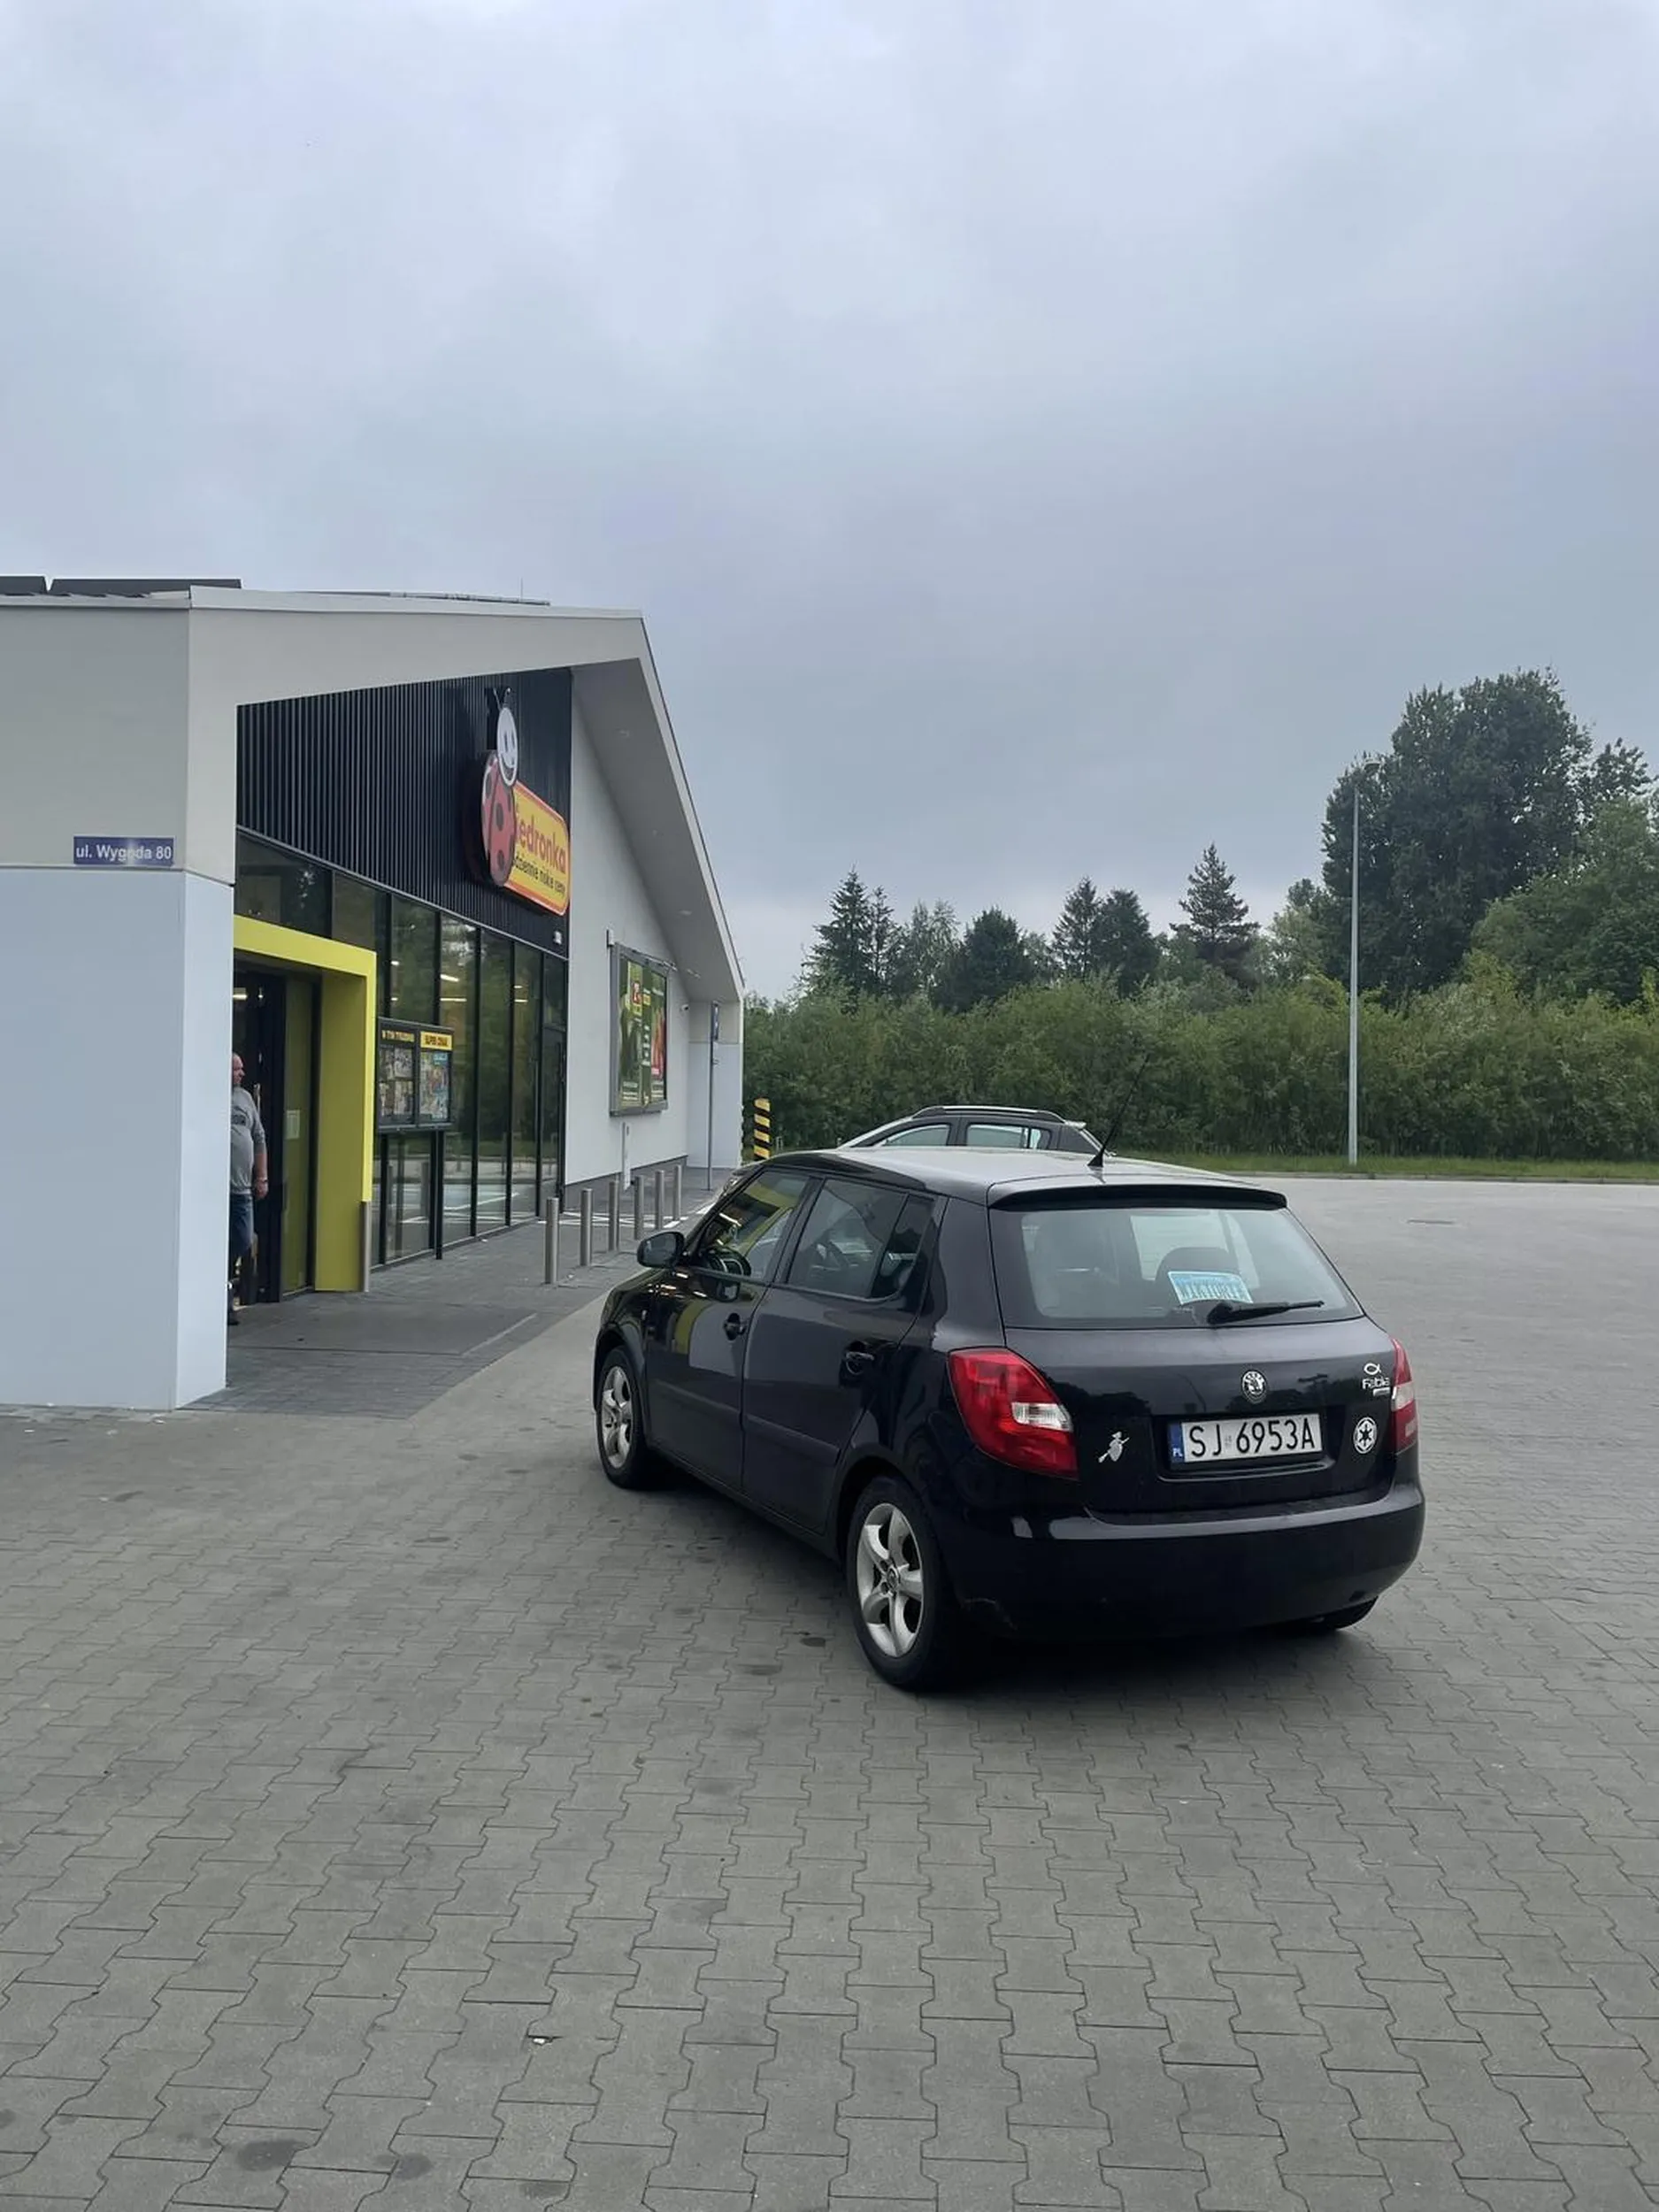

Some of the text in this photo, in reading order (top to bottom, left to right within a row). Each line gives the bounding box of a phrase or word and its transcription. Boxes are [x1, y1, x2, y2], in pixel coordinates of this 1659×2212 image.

[76, 845, 92, 858] ul.
[156, 846, 172, 860] 80
[516, 813, 566, 874] edronka
[1189, 1424, 1222, 1457] SJ
[1236, 1417, 1315, 1454] 6953A
